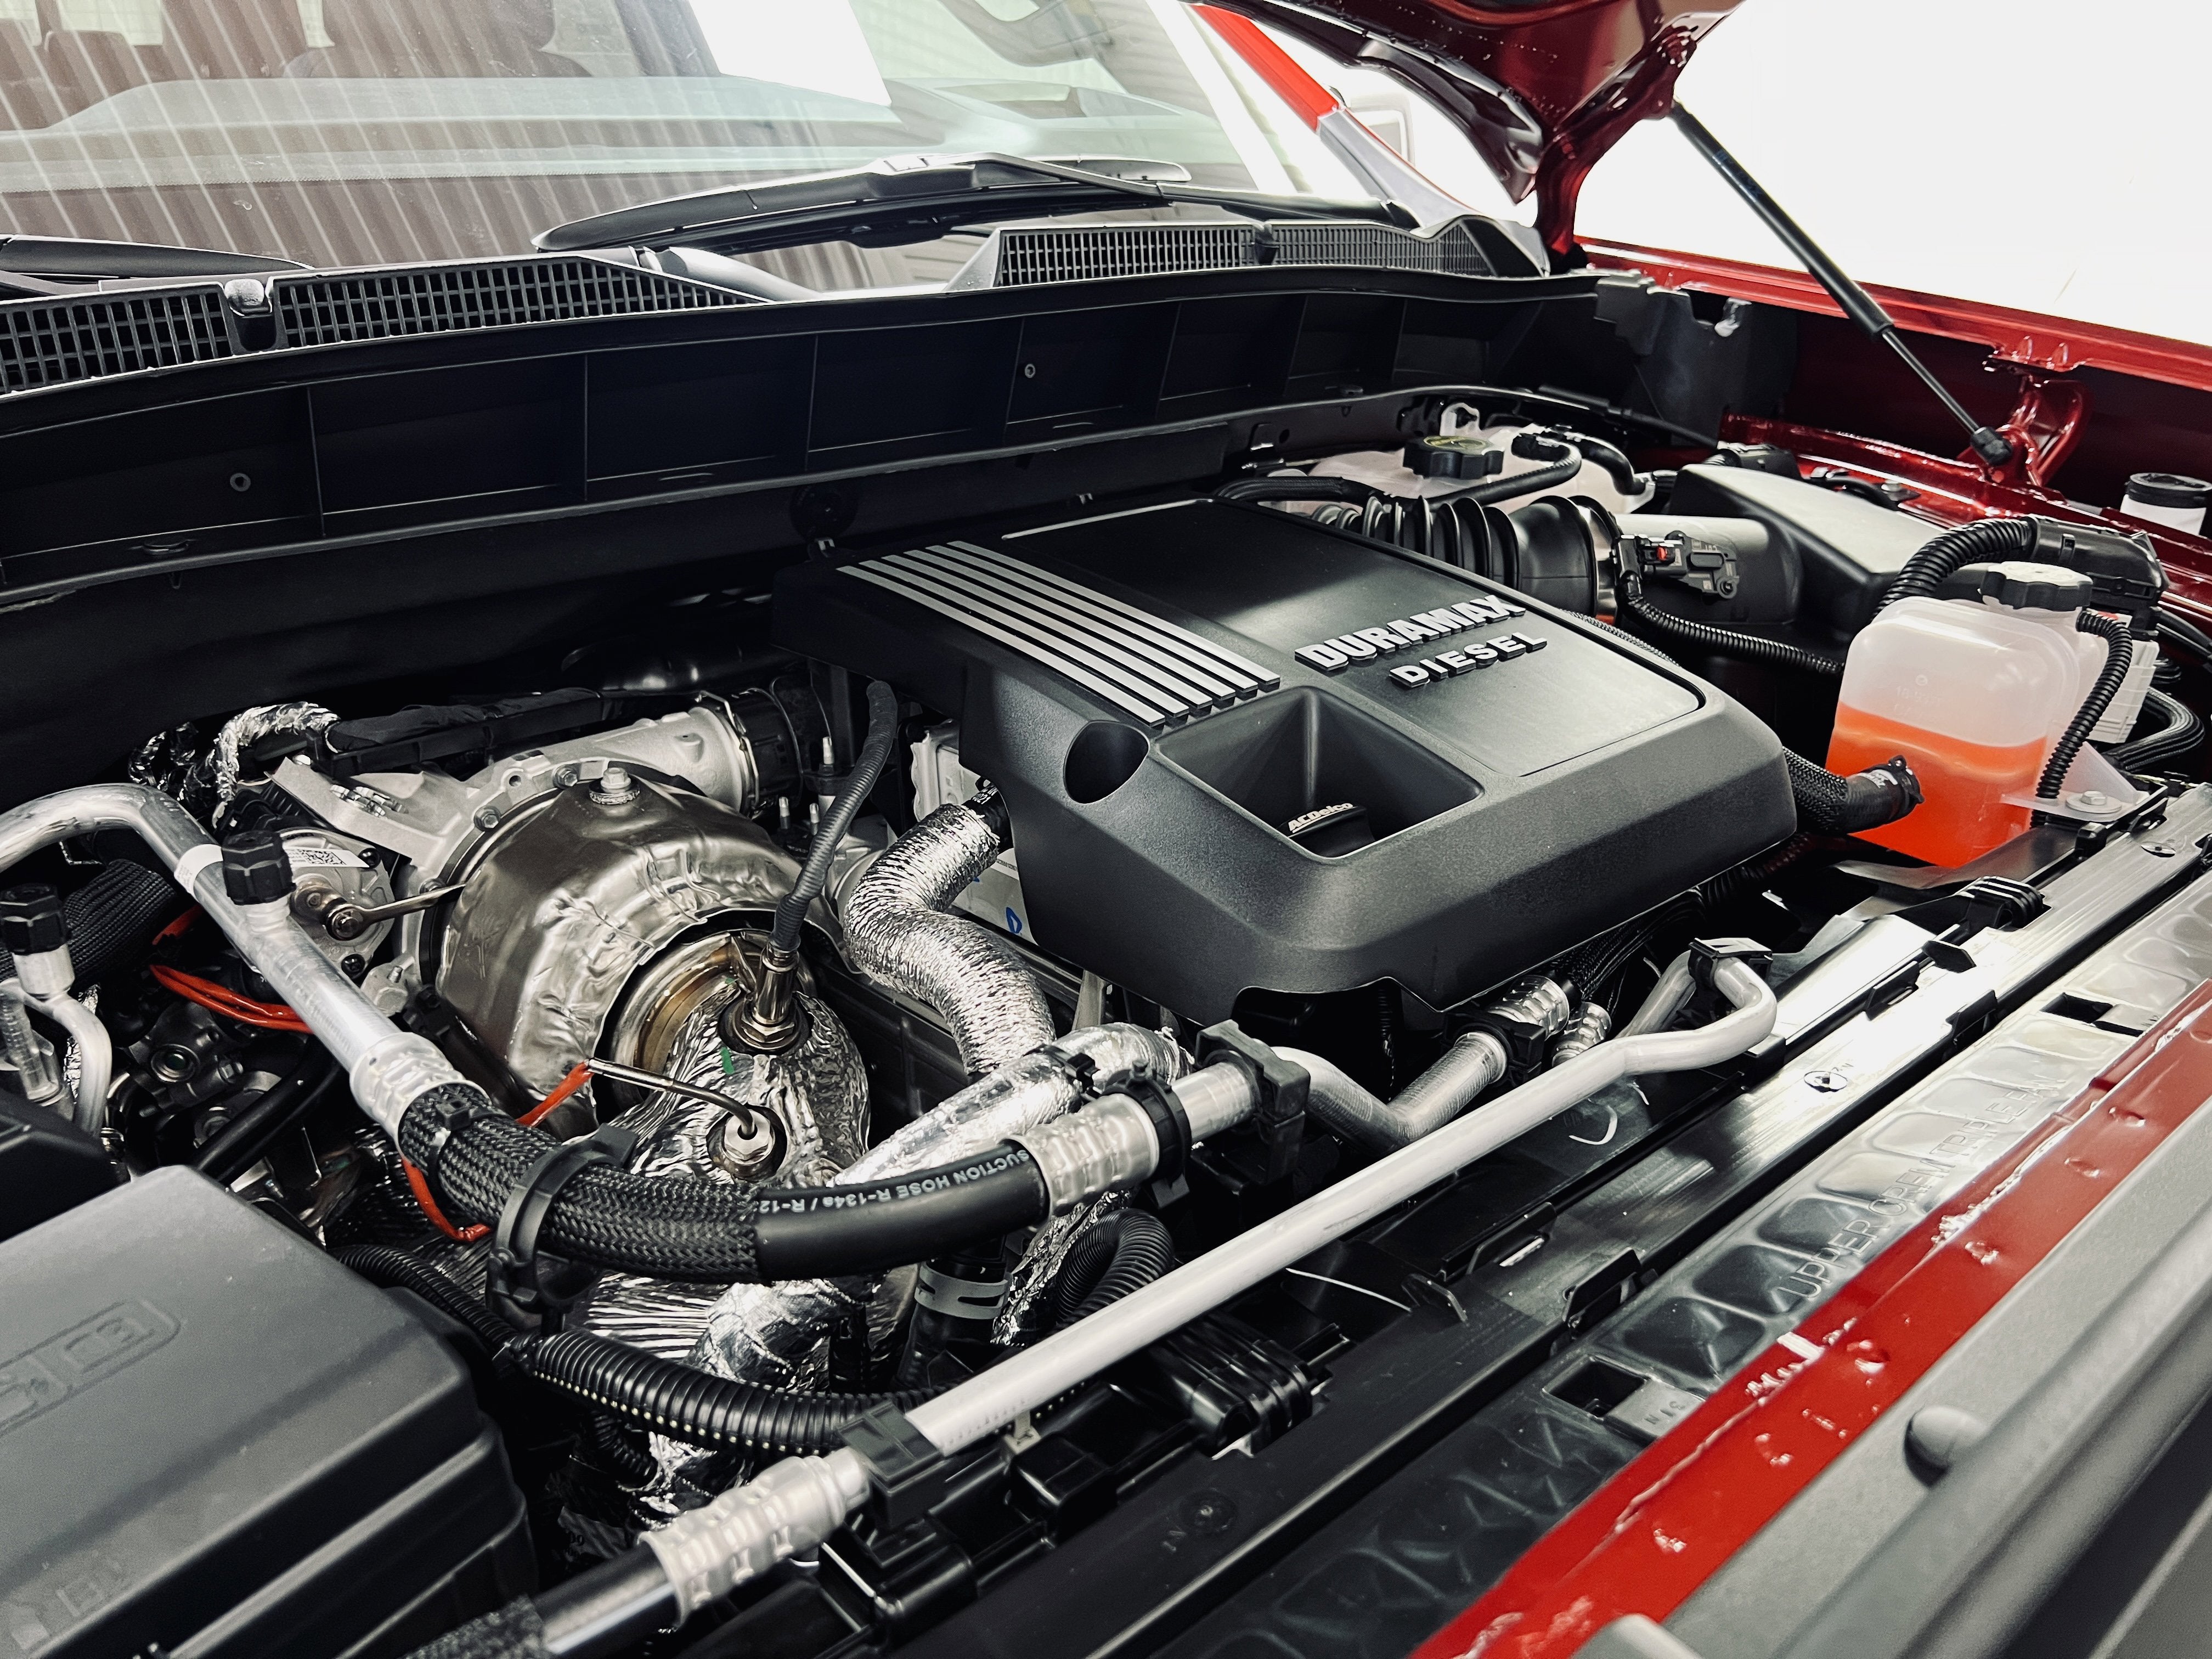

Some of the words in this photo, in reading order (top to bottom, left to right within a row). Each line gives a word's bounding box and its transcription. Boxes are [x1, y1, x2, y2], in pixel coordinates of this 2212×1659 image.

[1295, 595, 1526, 670] DURAMAX
[1390, 632, 1547, 687] DIESEL
[1288, 803, 1353, 831] ACDelco
[953, 1149, 1030, 1185] SUCTION
[823, 1188, 891, 1208] R-134a
[896, 1174, 951, 1199] HOSE
[1777, 1219, 1891, 1298] UPPER
[1929, 1102, 2028, 1156] TRIPLE
[810, 1198, 819, 1211] /
